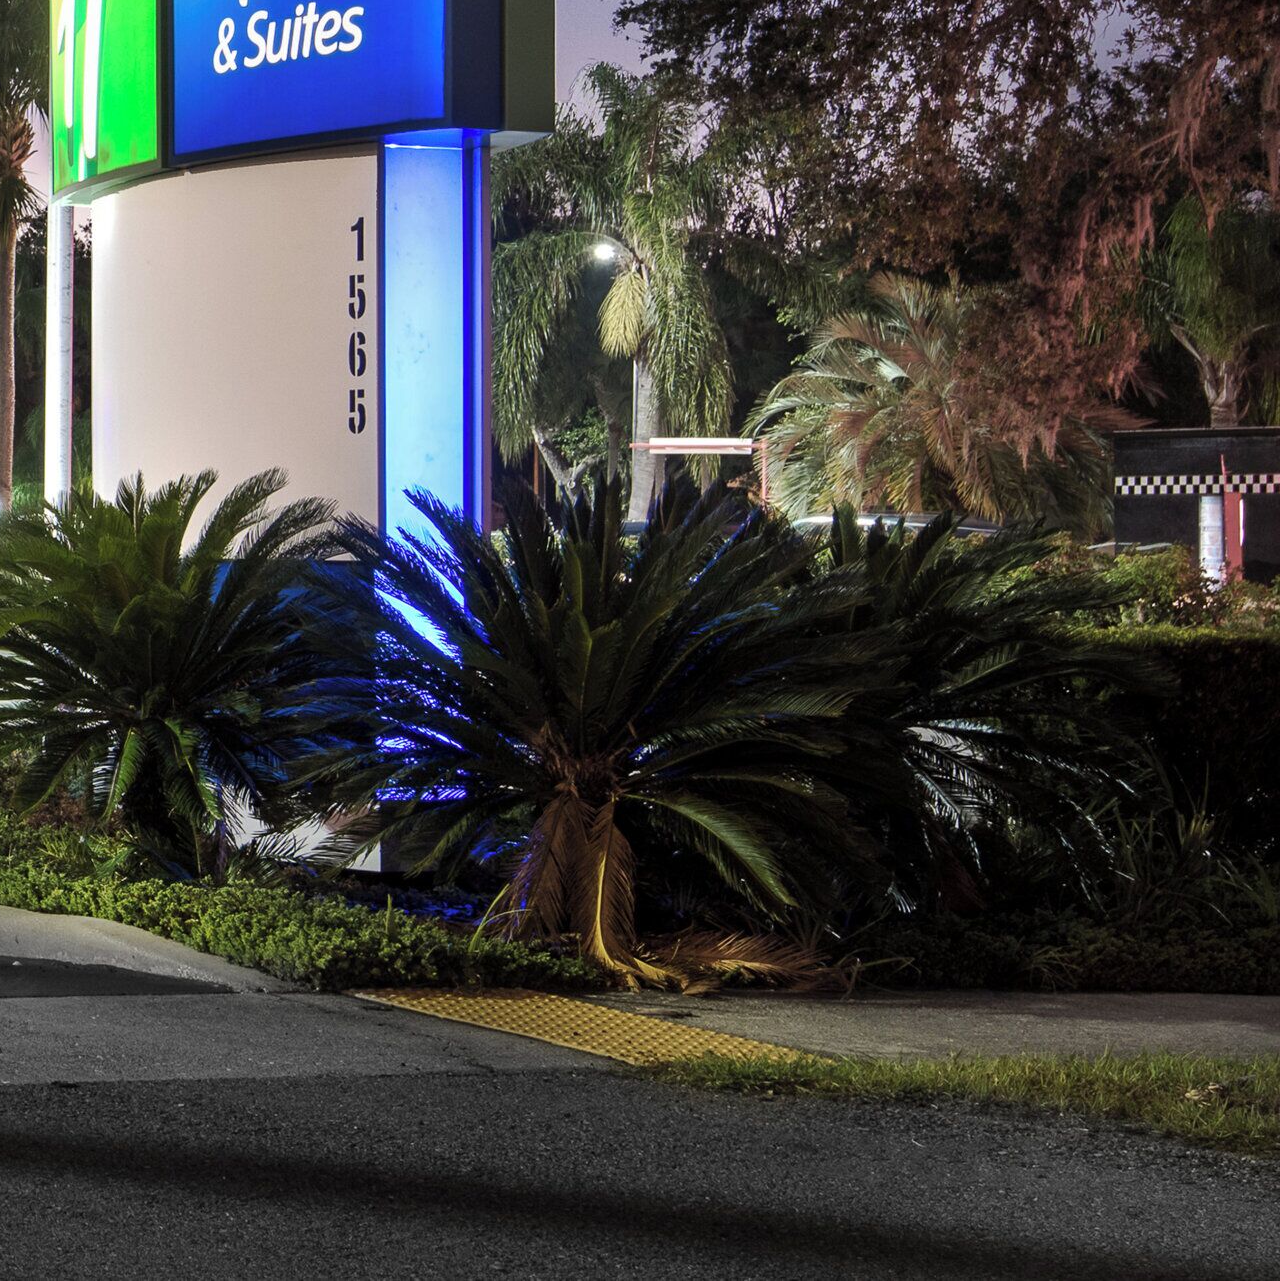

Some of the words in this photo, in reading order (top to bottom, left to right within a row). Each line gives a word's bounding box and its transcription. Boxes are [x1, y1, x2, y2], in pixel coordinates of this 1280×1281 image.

[213, 17, 238, 74] &
[244, 2, 365, 68] Suites
[348, 216, 367, 435] 1565
